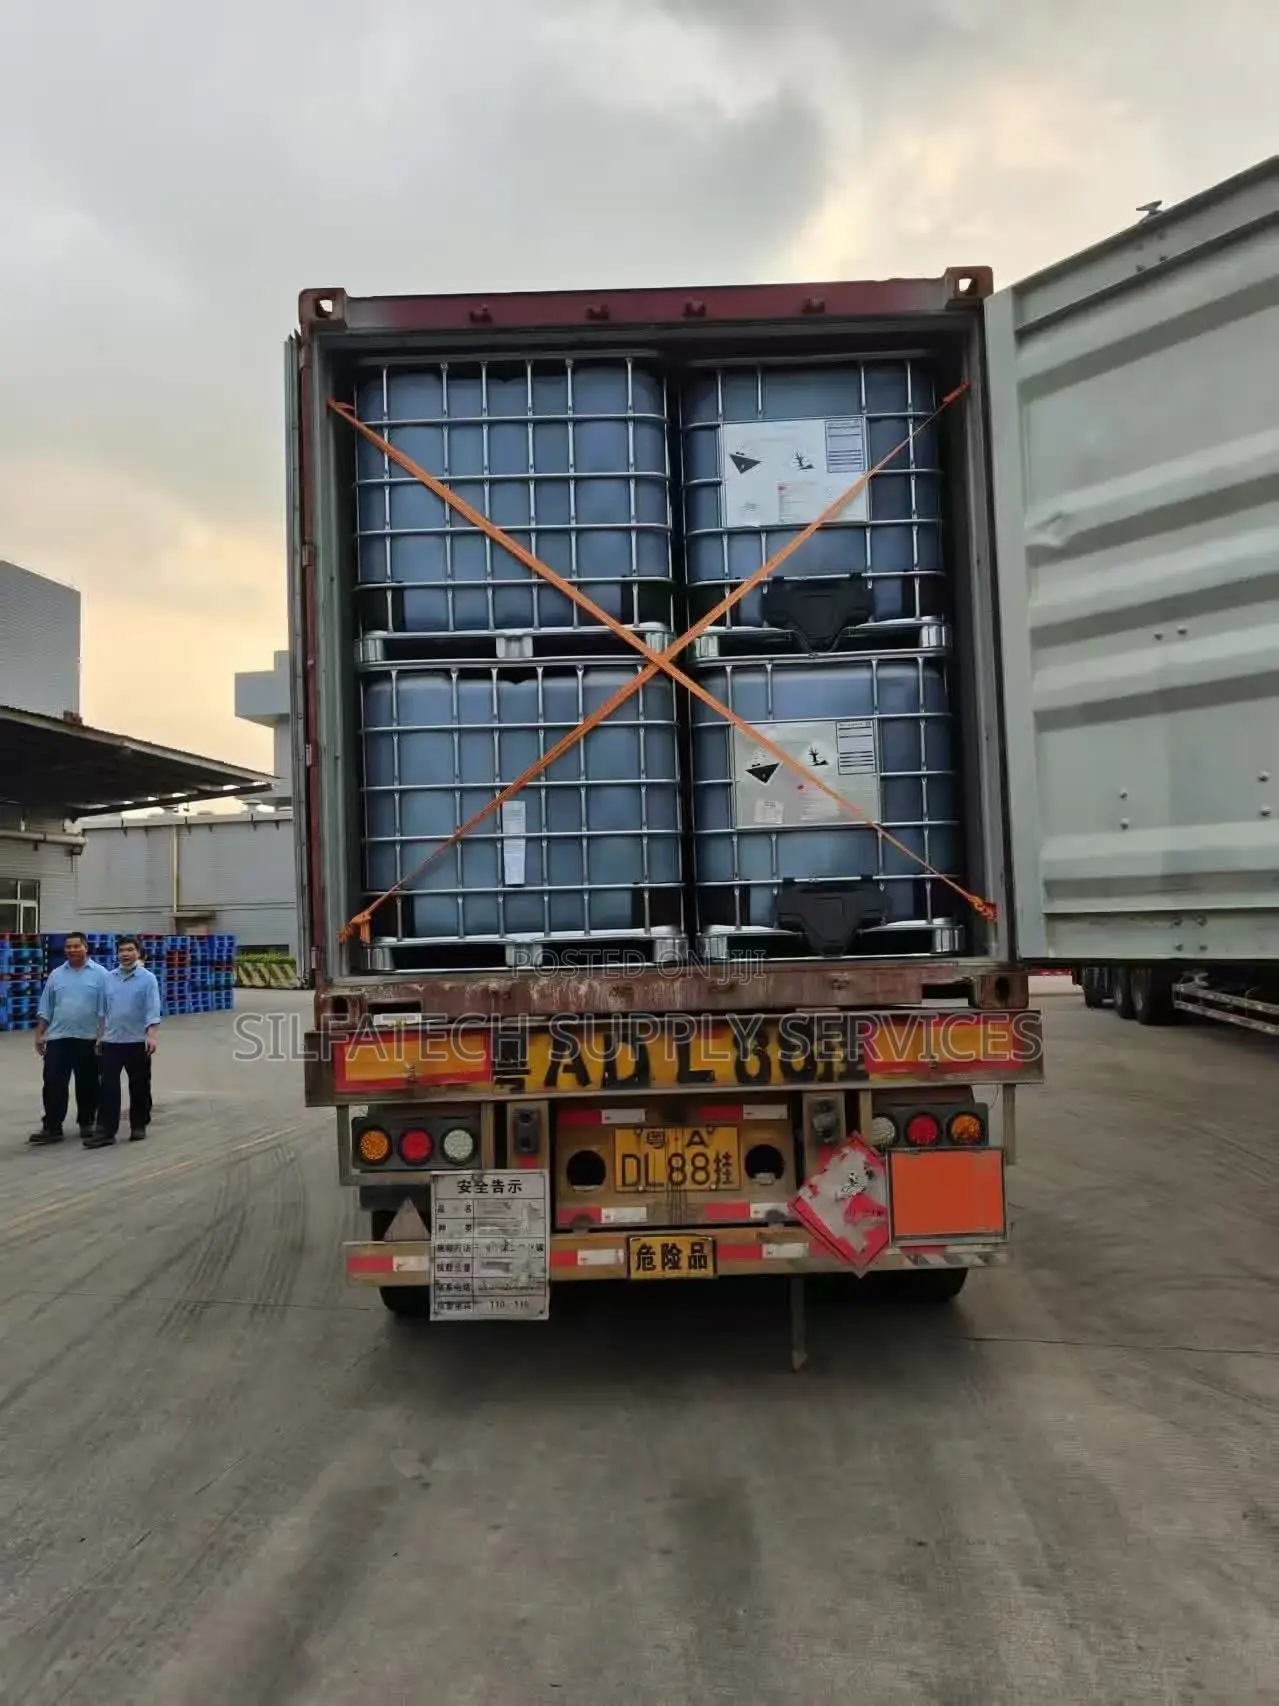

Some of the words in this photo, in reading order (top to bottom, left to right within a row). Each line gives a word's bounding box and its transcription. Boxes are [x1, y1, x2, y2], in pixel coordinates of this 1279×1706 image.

[621, 1151, 733, 1187] DL88挂
[457, 1179, 523, 1194] 安全告示
[636, 1242, 708, 1271] 危险品
